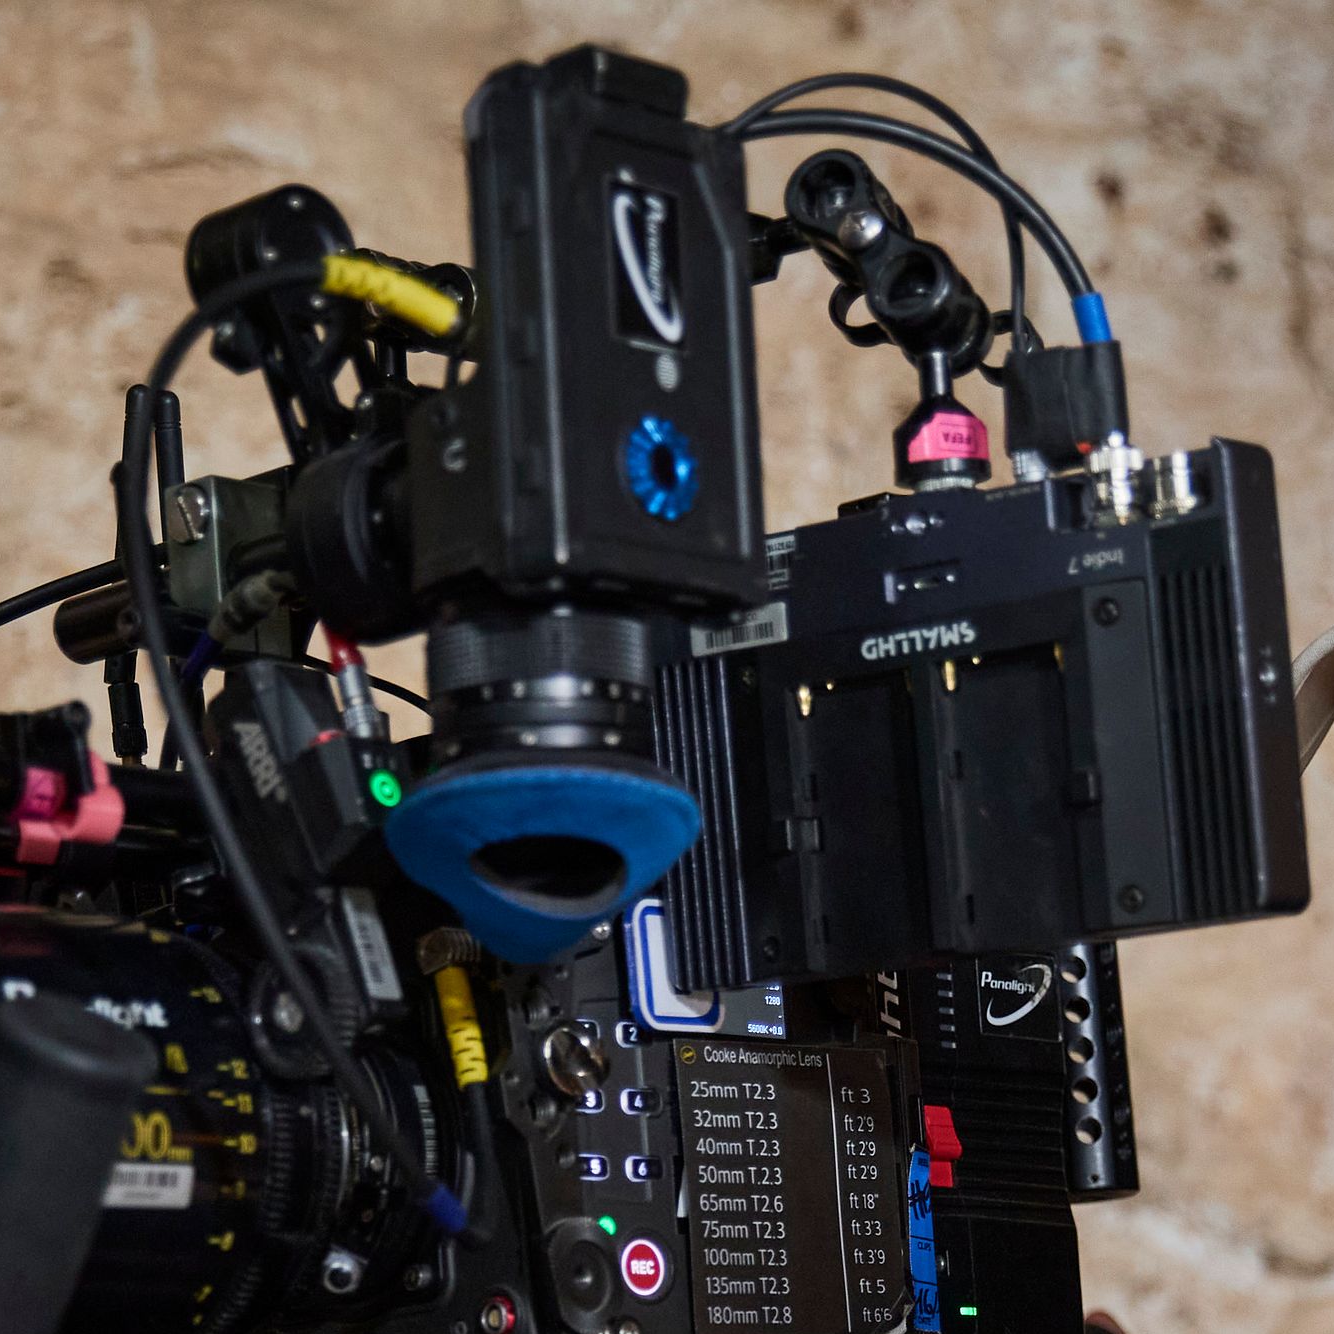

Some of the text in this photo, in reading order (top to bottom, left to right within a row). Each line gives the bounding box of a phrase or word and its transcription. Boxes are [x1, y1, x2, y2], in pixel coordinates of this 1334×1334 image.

[1068, 548, 1125, 575] Indie 7
[861, 620, 976, 660] SMALLHD
[981, 971, 1035, 994] Panalight
[703, 1046, 823, 1069] Cooke Anamorphic Lens
[584, 1090, 597, 1108] 3
[690, 1081, 776, 1100] 25mm T2.3
[841, 1087, 871, 1104] ft 3
[633, 1094, 643, 1108] 4
[693, 1110, 779, 1130] 32mm T2.3
[844, 1114, 875, 1132] ft 2'9
[696, 1138, 780, 1157] 40mm T.2.3
[846, 1140, 876, 1157] ft 2'9
[589, 1157, 601, 1175] 5
[638, 1161, 647, 1176] 6
[847, 1164, 878, 1180] ft 2'9
[698, 1166, 782, 1185] 50mm T.2.3
[699, 1194, 784, 1213] 65mm T2.6
[849, 1193, 879, 1209] ft 18"
[701, 1220, 786, 1239] 75mm T2.3
[851, 1220, 882, 1236] ft 3'3
[704, 1248, 788, 1266] 100mm T2.3
[854, 1248, 886, 1265] ft 3'9
[630, 1259, 656, 1275] REC
[706, 1277, 790, 1295] 135mm T2.3
[859, 1279, 886, 1294] ft 5
[707, 1307, 793, 1325] 180mm T2.8
[862, 1307, 892, 1322] ft 6'6
